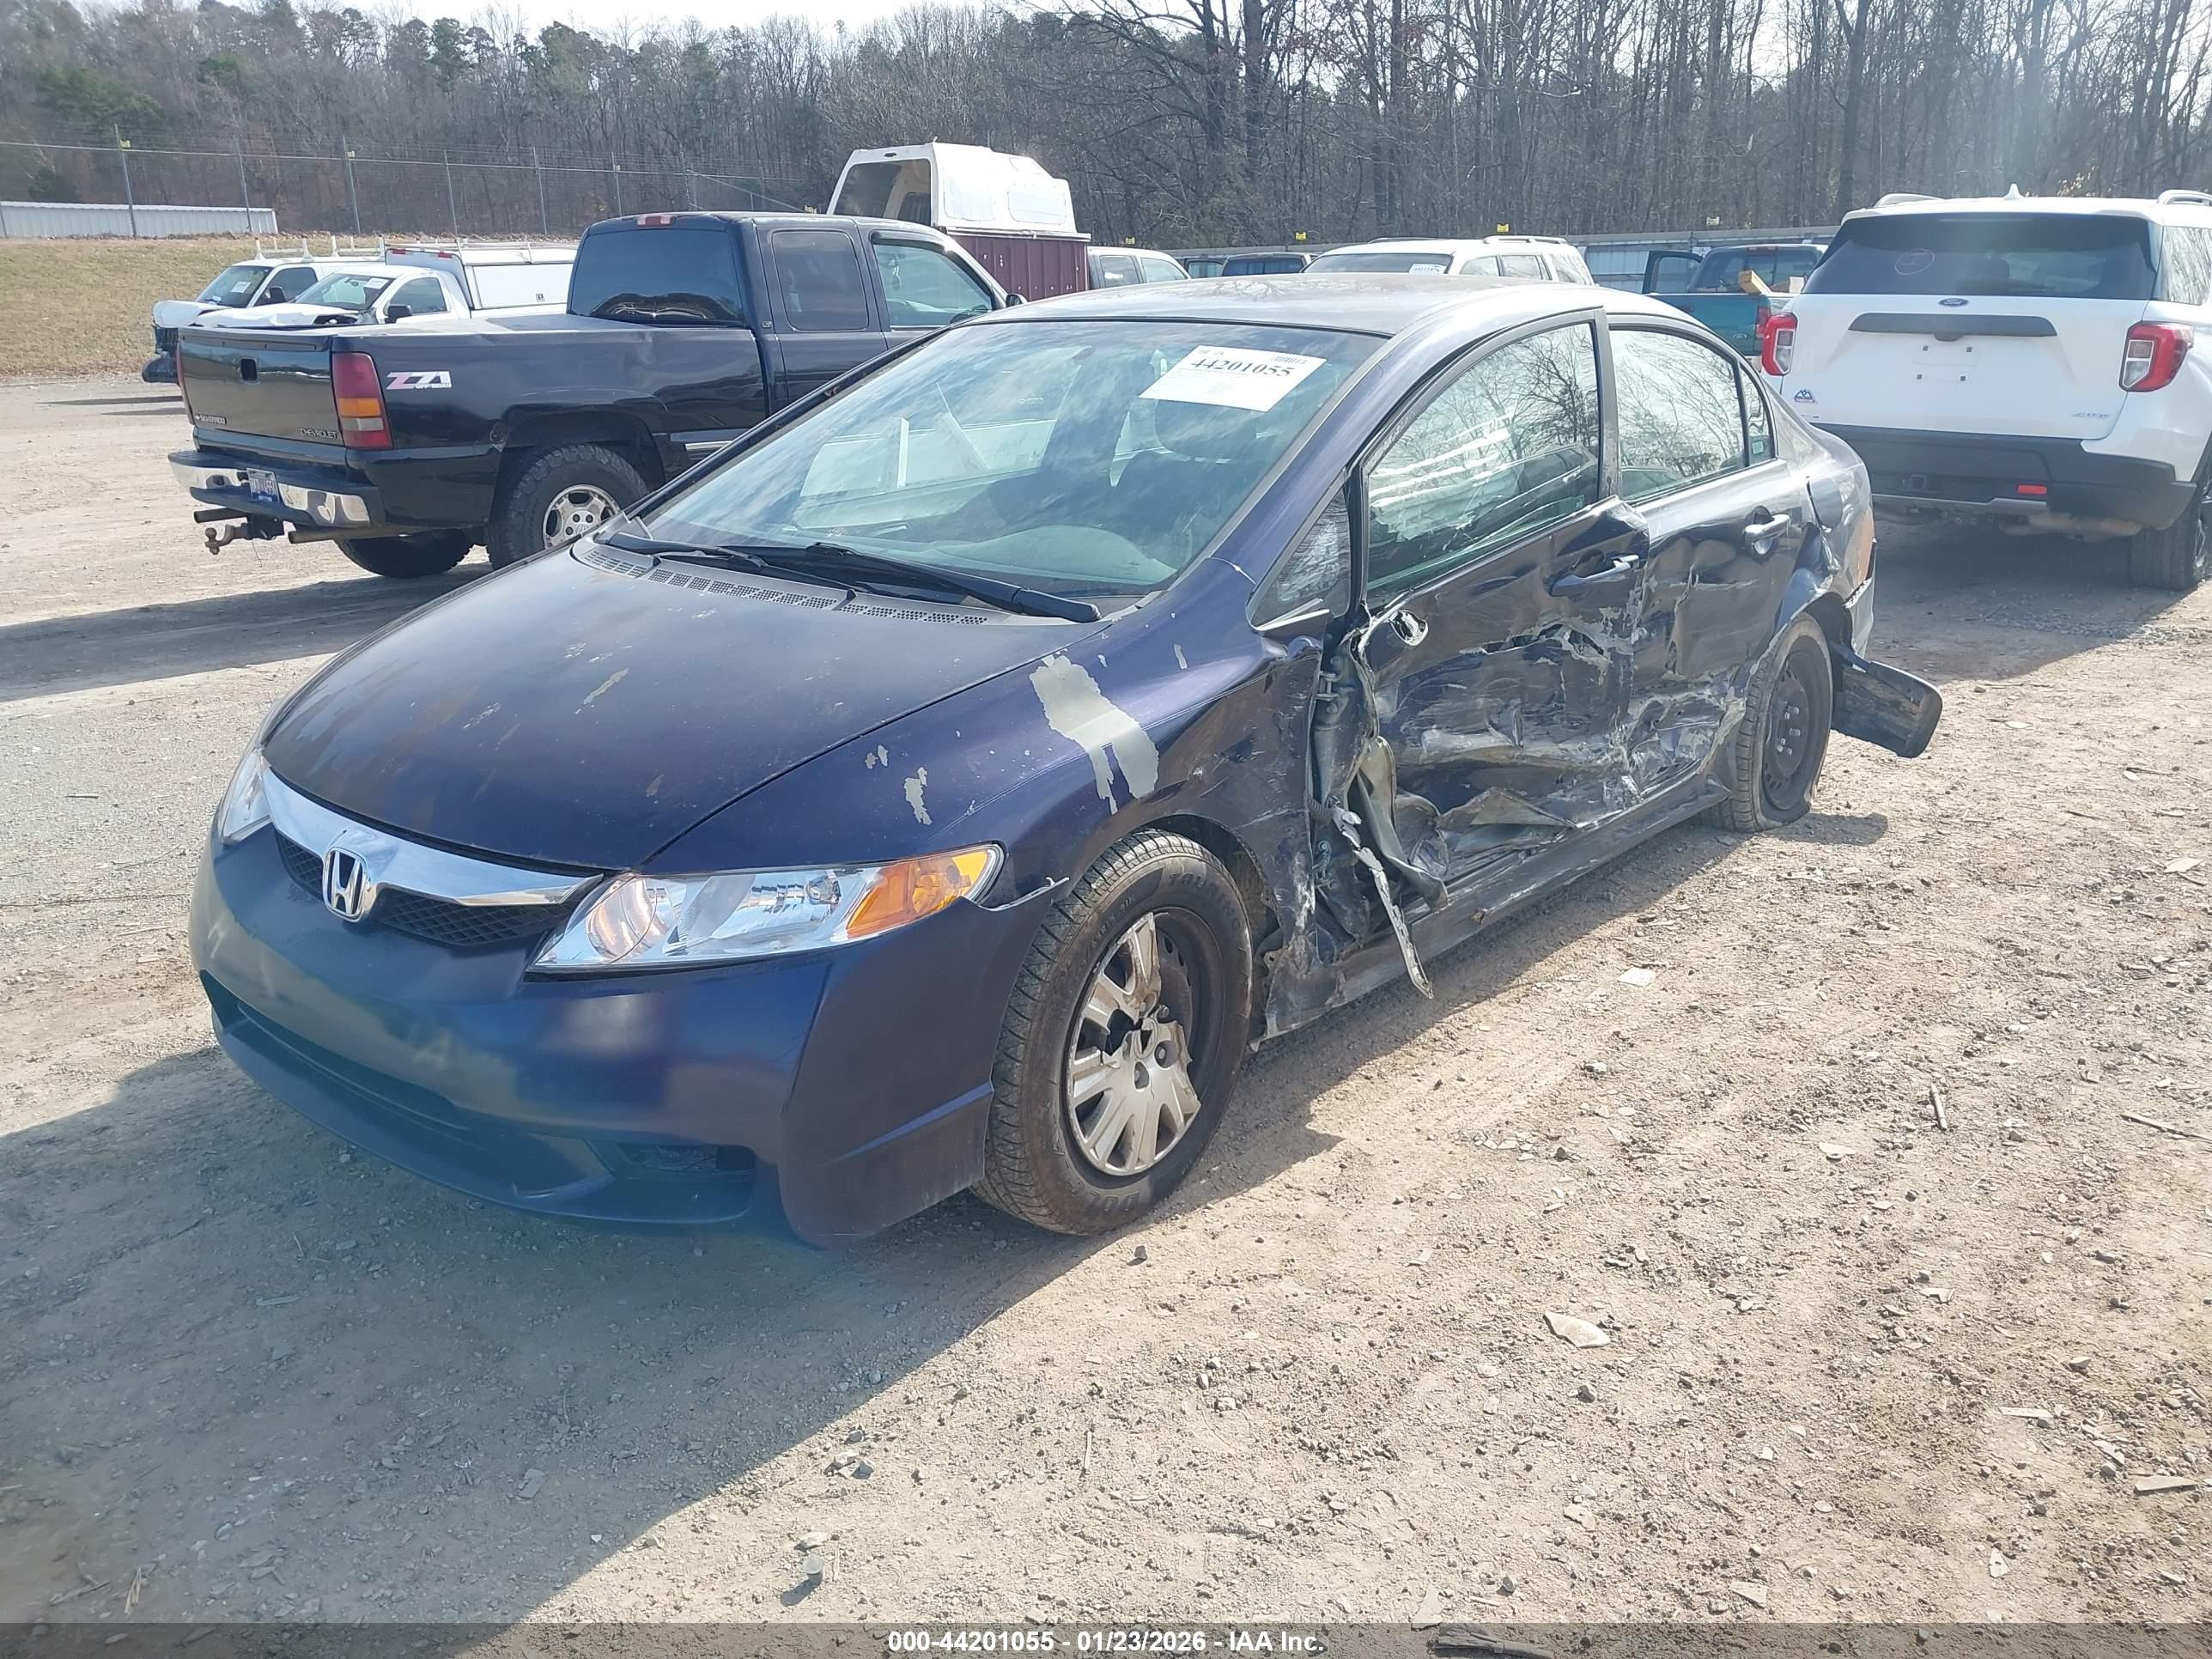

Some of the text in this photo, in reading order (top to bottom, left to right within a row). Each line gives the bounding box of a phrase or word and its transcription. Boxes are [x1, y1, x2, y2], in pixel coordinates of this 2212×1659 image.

[1190, 358, 1297, 377] 44201055
[386, 370, 452, 390] Z71
[301, 428, 338, 440] CHEVROLET
